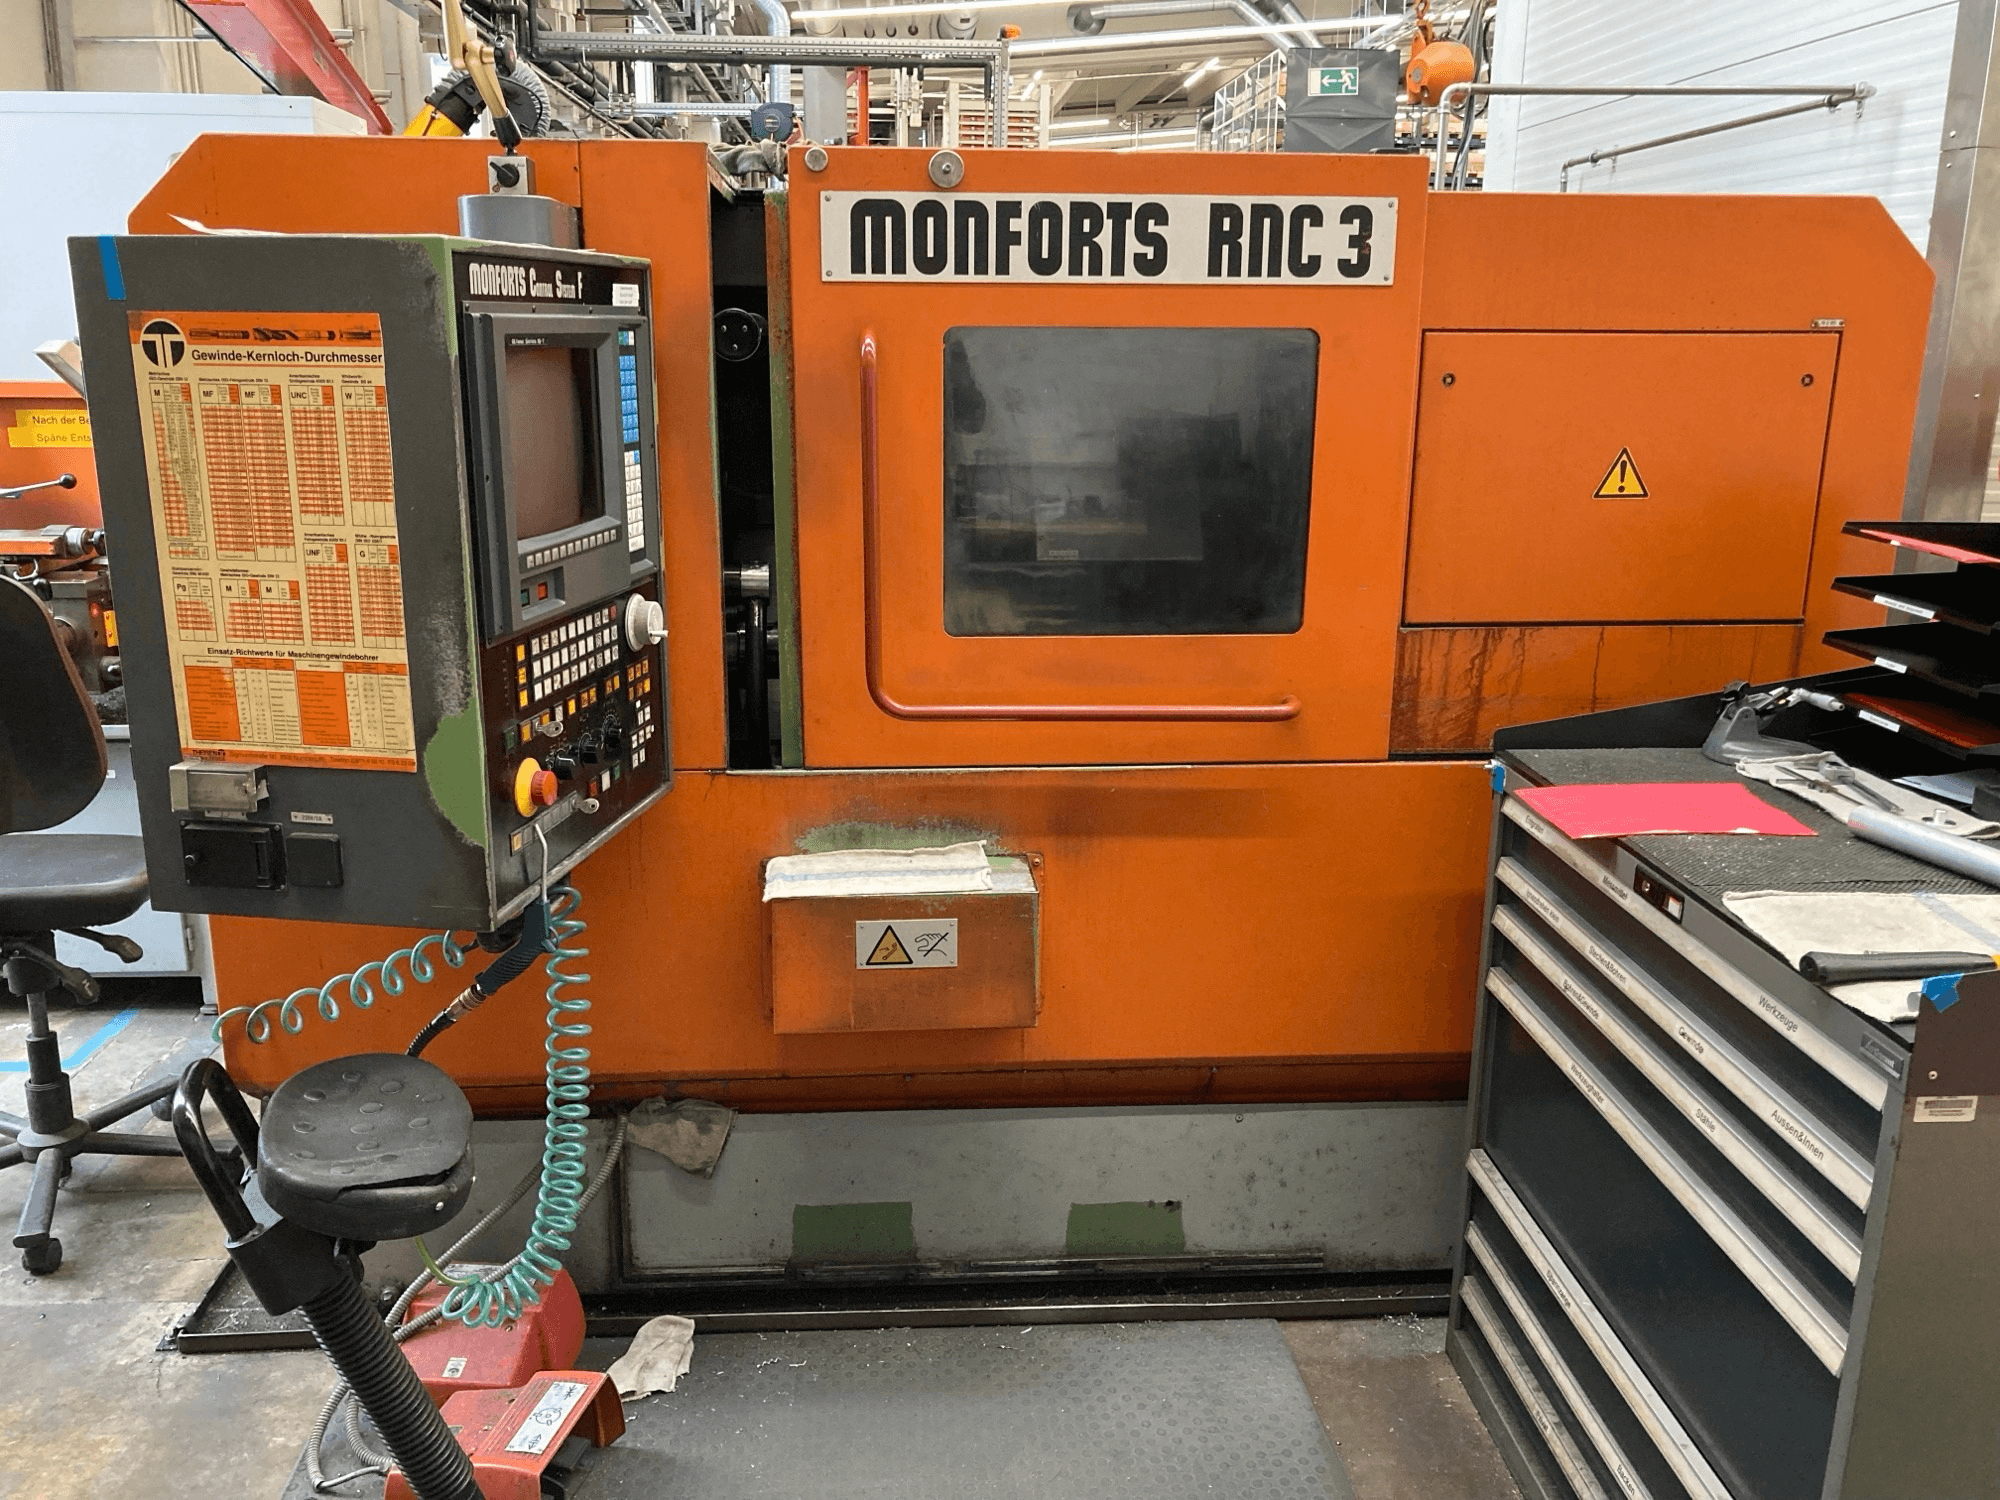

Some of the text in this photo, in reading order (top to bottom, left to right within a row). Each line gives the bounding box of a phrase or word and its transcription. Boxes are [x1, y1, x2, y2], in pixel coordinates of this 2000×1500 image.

[850, 198, 1373, 278] MONFORTS RNC 3
[469, 262, 526, 297] MONFORTS
[577, 271, 583, 300] F
[191, 349, 383, 364] Gewinde-Kernloch-Durchmesser
[290, 391, 307, 399] UNC
[344, 392, 353, 400] W
[32, 415, 58, 425] Nach
[60, 415, 76, 425] der
[176, 583, 187, 592] Pg
[207, 647, 379, 662] Einsatz-Richtwerte für Maschinengewindebohrer
[1588, 945, 1627, 984] Stechen&Bohren
[1562, 978, 1599, 1020] Bohren&Gewinde
[1758, 995, 1799, 1033] Werkzeuge
[1678, 1026, 1704, 1054] Gewinde
[1570, 1062, 1604, 1104] Werkzeughalter
[1771, 1109, 1824, 1161] Aussen&Innen
[1616, 1464, 1635, 1496] Backen
